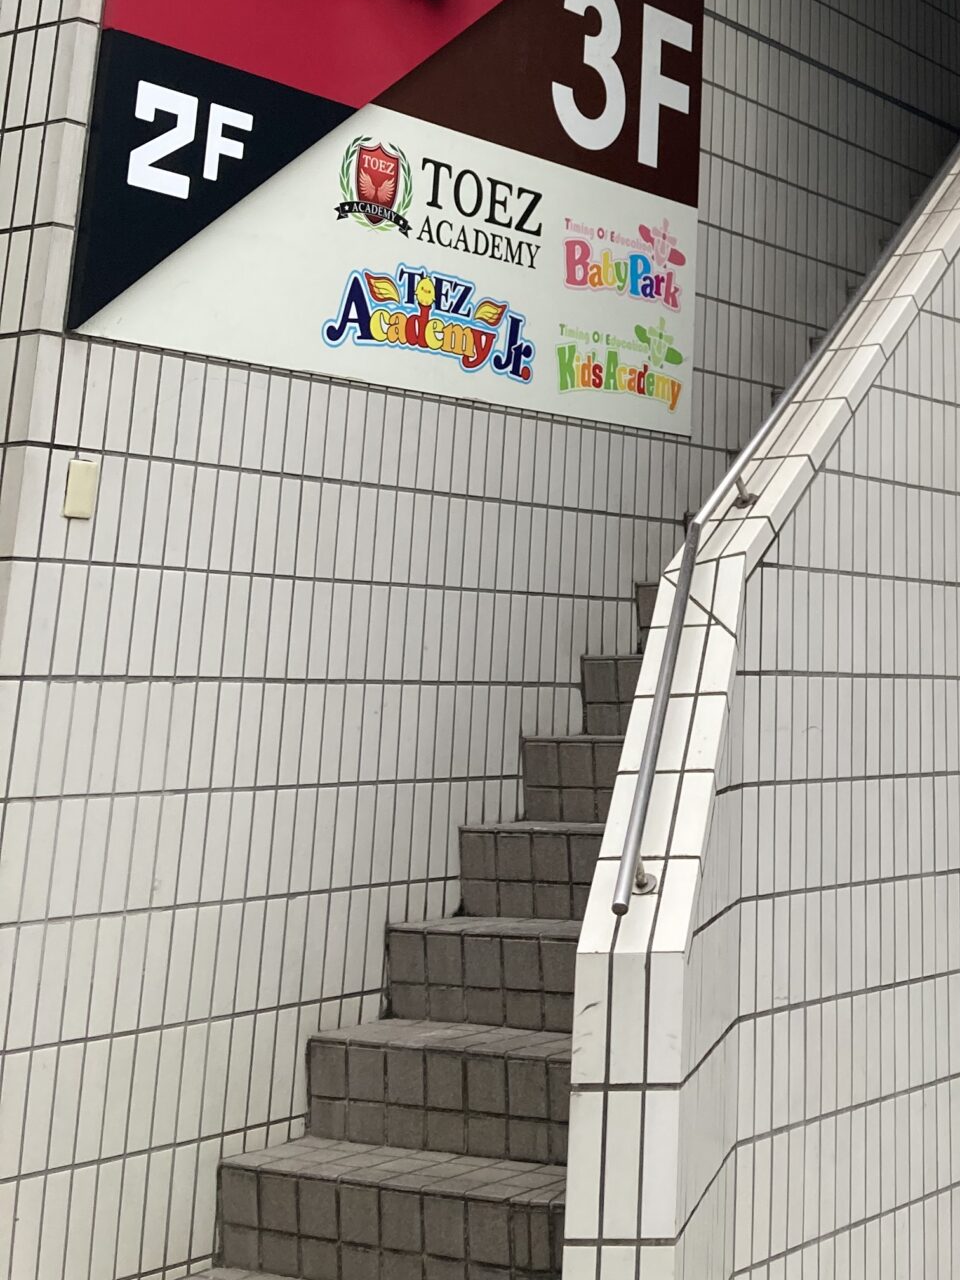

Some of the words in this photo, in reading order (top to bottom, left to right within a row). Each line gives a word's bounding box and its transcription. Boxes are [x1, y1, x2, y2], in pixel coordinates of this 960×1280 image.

[126, 79, 254, 201] 2F
[362, 154, 395, 176] TOEZ
[352, 202, 397, 222] ACADEMY
[421, 157, 543, 237] TOEZ
[416, 215, 541, 269] ACADEMY
[565, 218, 595, 239] Timing
[327, 276, 496, 369] Academy
[559, 323, 590, 344] Timing
